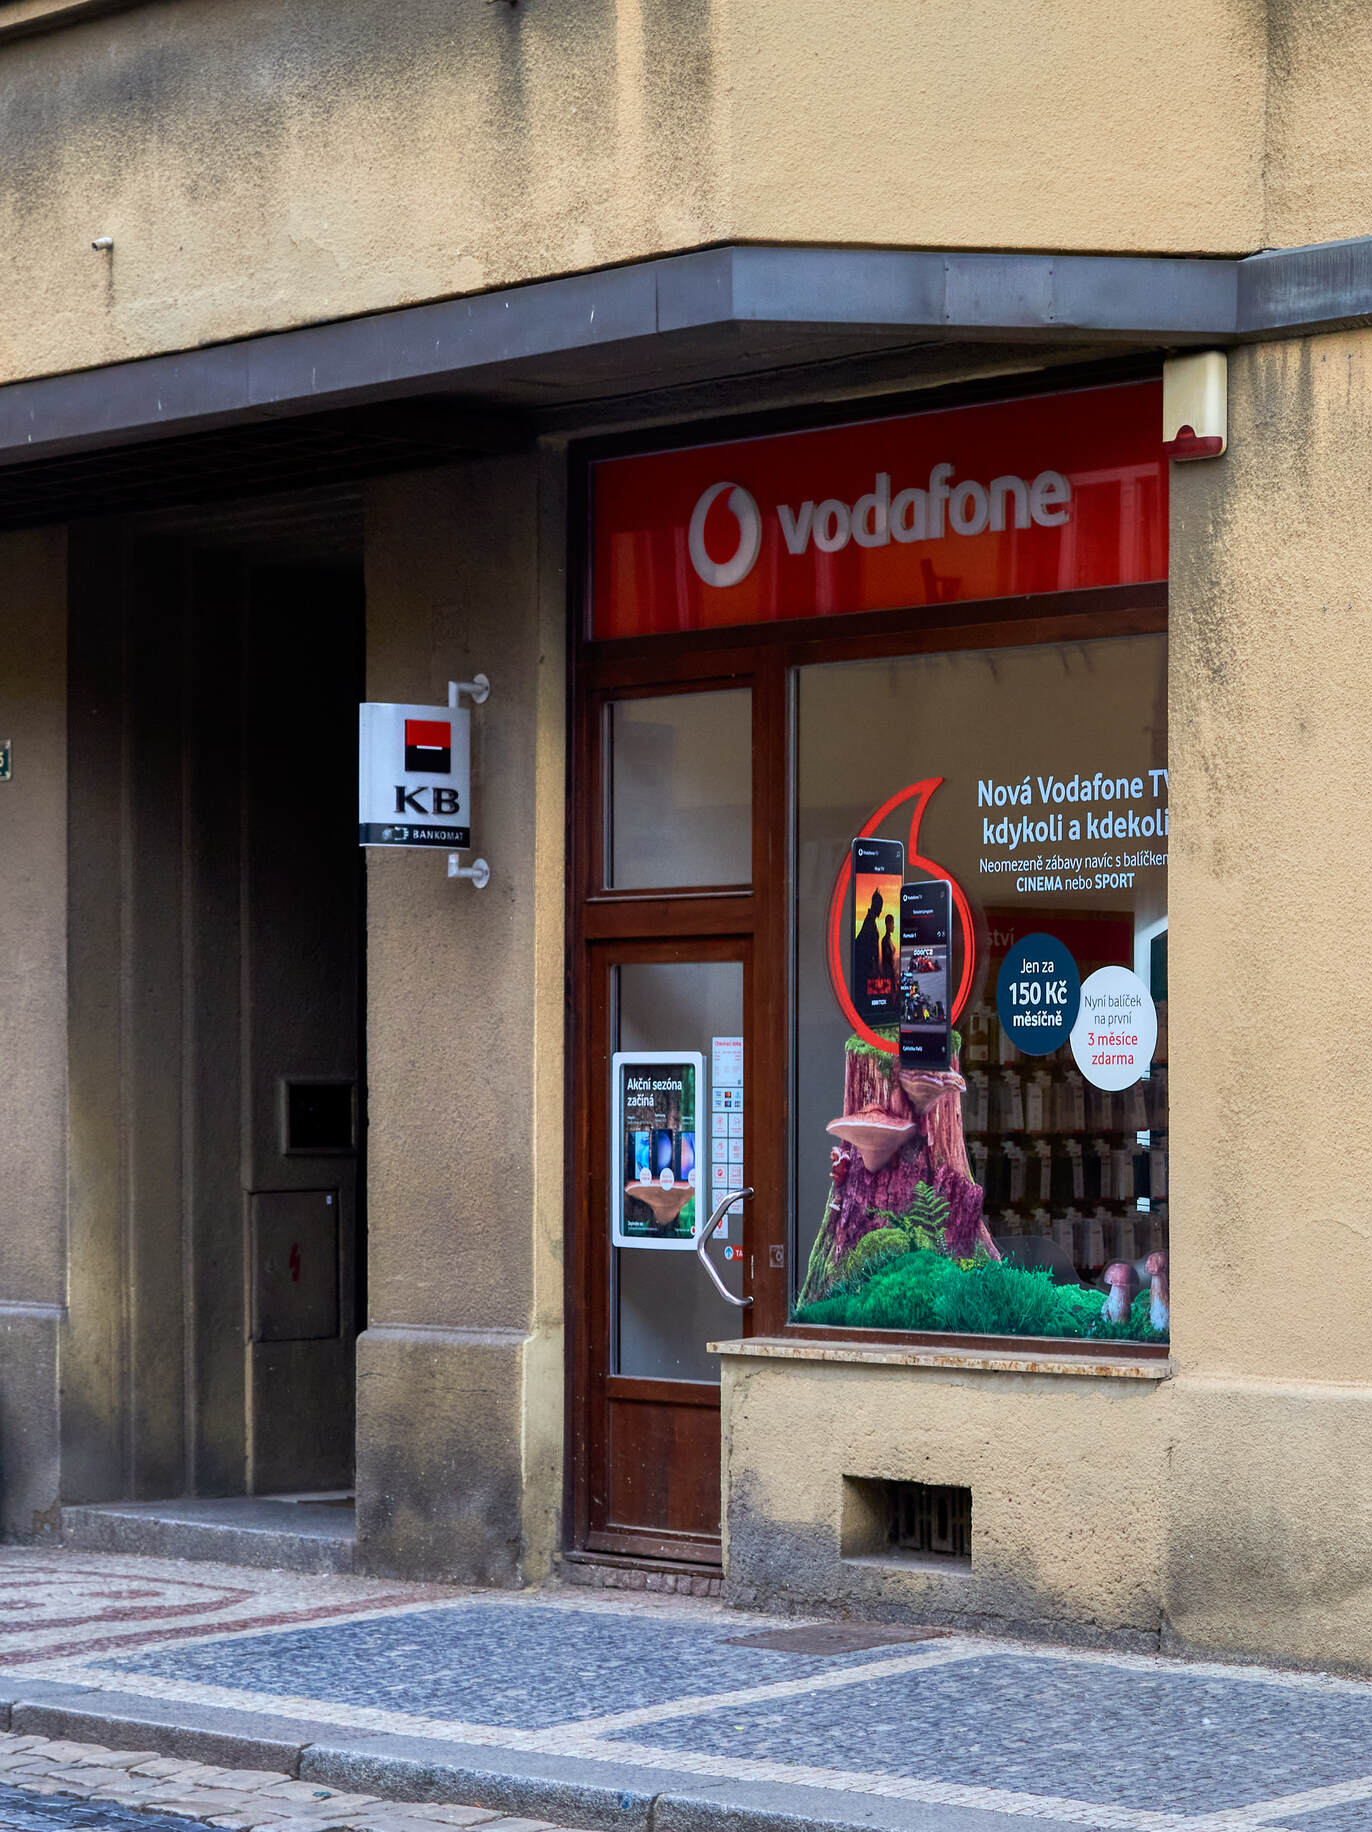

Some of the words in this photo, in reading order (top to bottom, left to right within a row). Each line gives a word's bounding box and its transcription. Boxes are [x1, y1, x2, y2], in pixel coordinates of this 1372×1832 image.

[777, 462, 1072, 555] vodafone
[977, 776, 1032, 808] Nová
[1037, 772, 1144, 804] Vodafone
[394, 785, 460, 815] KB
[412, 829, 464, 841] BANKOMAT
[983, 814, 1063, 851] kdykoli
[1068, 818, 1081, 841] a
[1087, 808, 1168, 840] kdekoli
[979, 855, 1043, 873] Neomezeně
[1045, 853, 1083, 873] zábavy
[1084, 852, 1113, 869] navíc
[1115, 855, 1121, 868] s
[1016, 876, 1063, 893] CINEMA
[1065, 875, 1093, 891] nebo
[1095, 872, 1136, 889] SPORT
[1020, 958, 1040, 974] Jen
[1041, 961, 1055, 973] za
[1008, 982, 1041, 1006] 150
[1045, 979, 1068, 1005] Kč
[1084, 995, 1107, 1011] Nyní
[1108, 994, 1142, 1008] balíček
[1012, 1010, 1063, 1027] měsíčně
[1094, 1014, 1106, 1025] na
[1107, 1012, 1133, 1028] první
[1087, 1032, 1095, 1046] 3
[1097, 1031, 1138, 1046] měsíce
[1091, 1051, 1134, 1065] zdarma
[627, 1077, 651, 1092] Akční
[652, 1078, 683, 1092] sezóna
[626, 1093, 655, 1107] začíná
